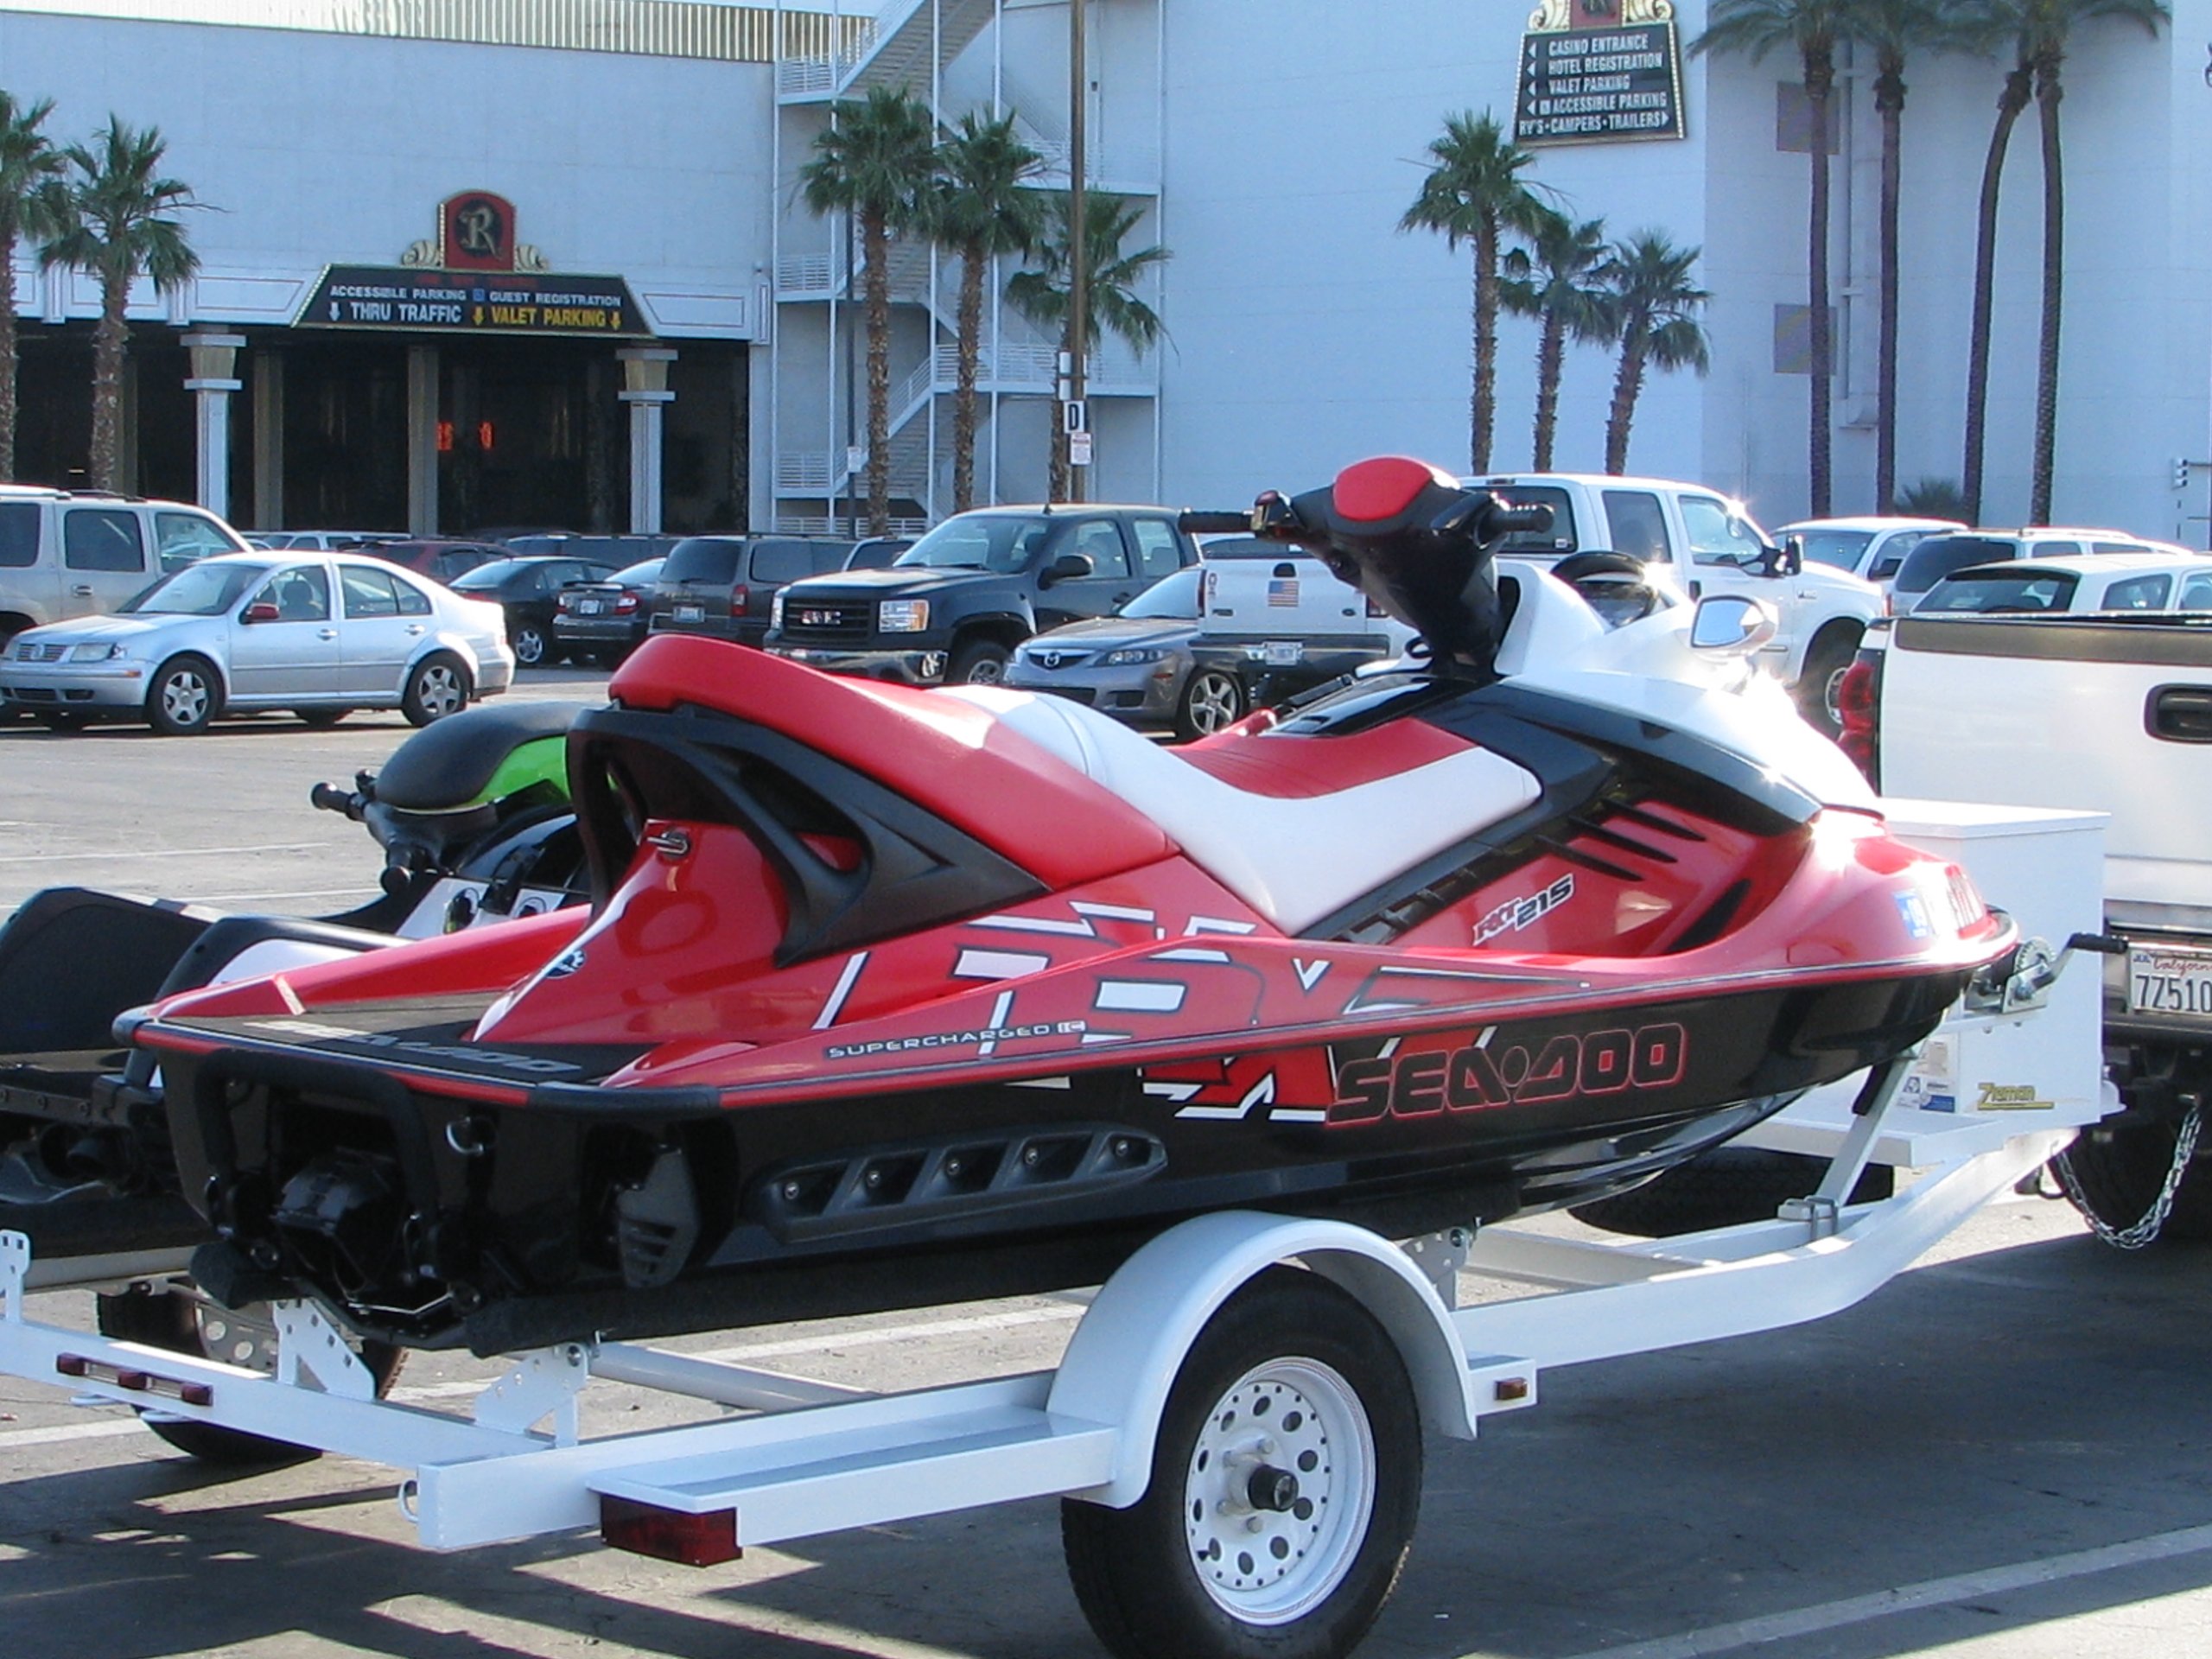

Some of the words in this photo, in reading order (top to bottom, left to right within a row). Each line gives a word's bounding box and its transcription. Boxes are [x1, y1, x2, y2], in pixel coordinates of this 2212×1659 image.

[1548, 39, 1588, 57] CASINO
[1592, 34, 1649, 54] ENTRANCE
[1548, 58, 1582, 75] HOTEL
[1585, 53, 1662, 72] REGISTRATION
[1548, 78, 1581, 95] VALET
[1583, 74, 1630, 91] PARKING
[1554, 95, 1616, 114] ACCESSIBLE
[1619, 92, 1667, 110] PARKING
[1550, 115, 1602, 133] CAMPERS
[1609, 111, 1661, 130] TRAILERS
[330, 284, 407, 299] ACCESSIBLE
[412, 289, 467, 301] PARKING
[489, 290, 531, 303] GUEST
[535, 292, 622, 307] REGISTRATION
[350, 302, 391, 321] THRU
[398, 304, 462, 323] TRAFFIC
[491, 306, 537, 326] VALET
[543, 308, 607, 327] PARKING
[1068, 404, 1079, 431] D
[829, 1024, 1050, 1058] SUPERCHARGED
